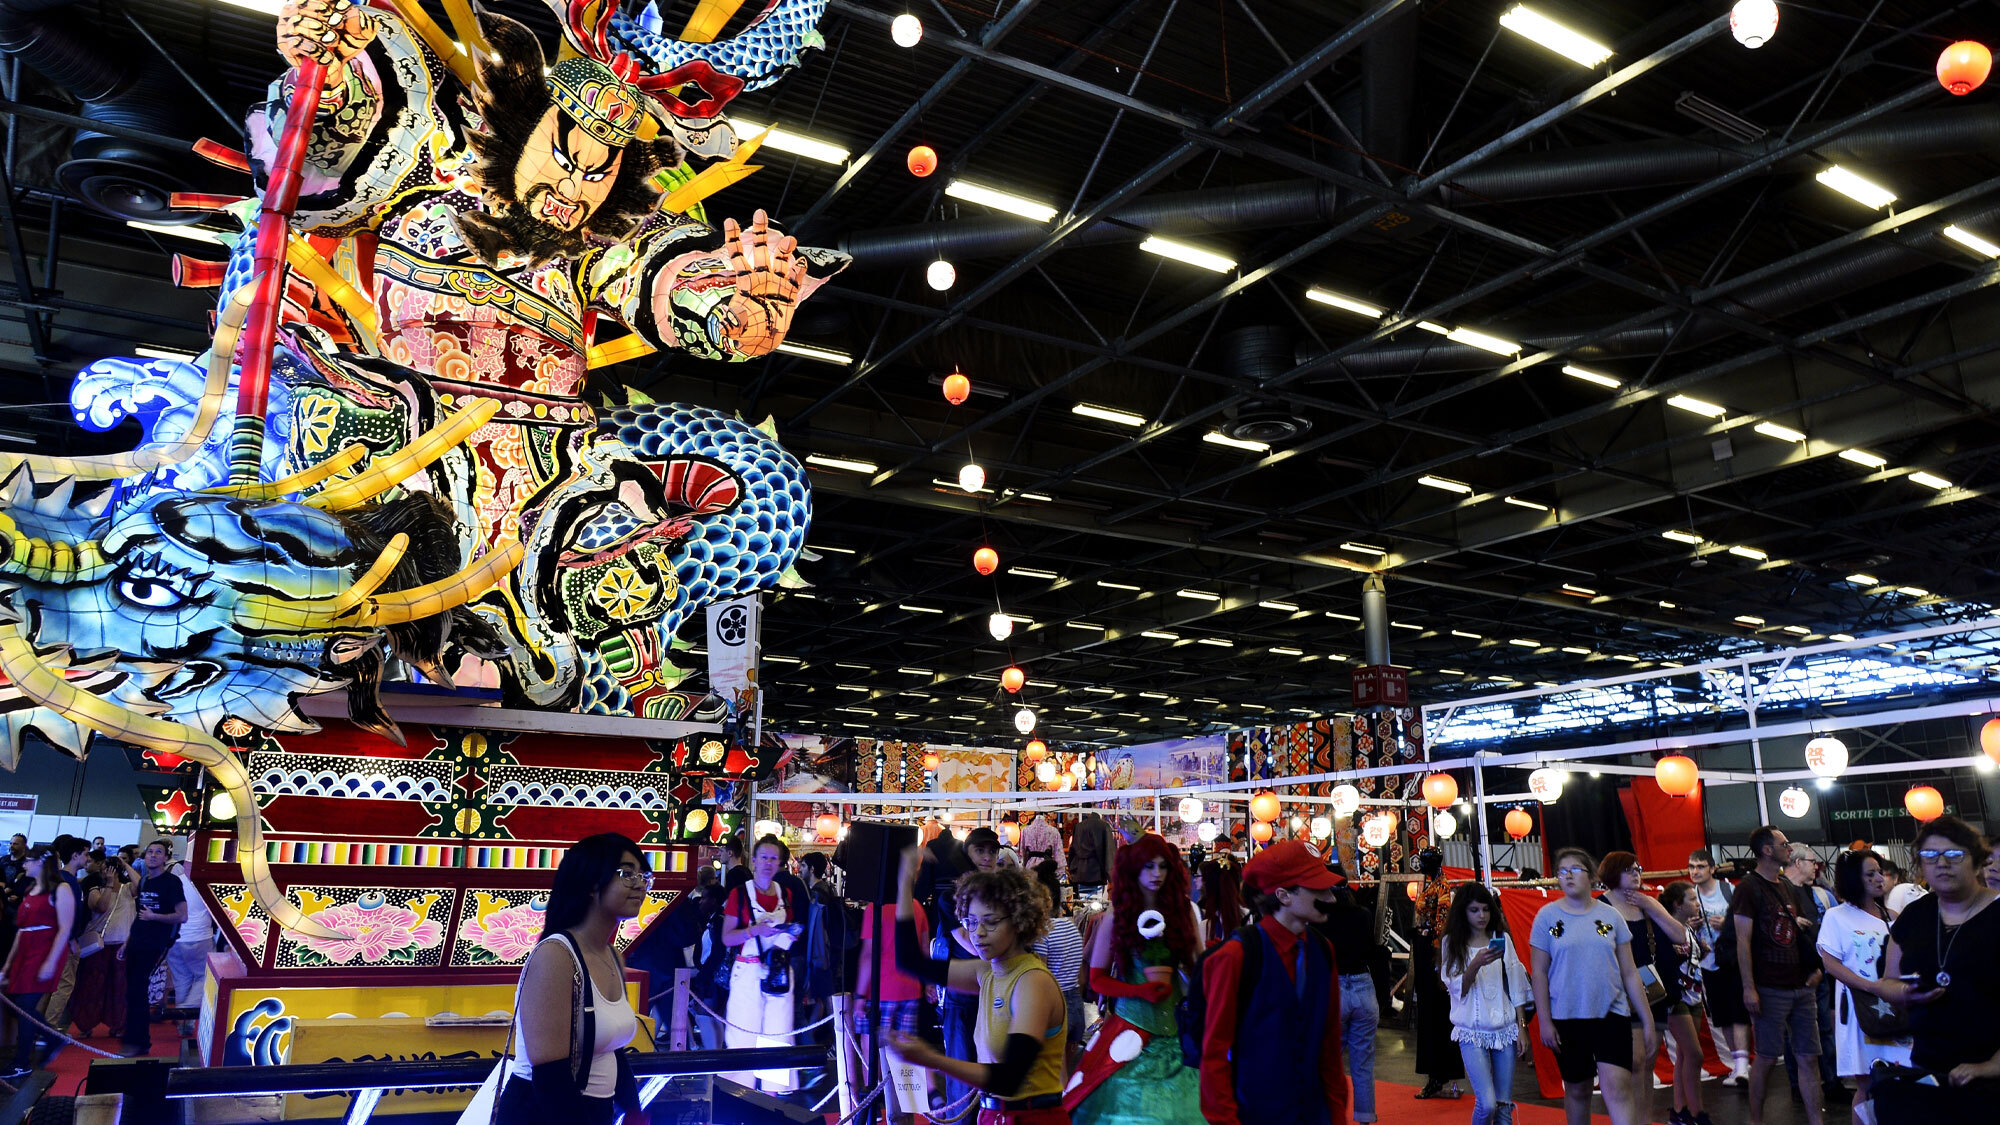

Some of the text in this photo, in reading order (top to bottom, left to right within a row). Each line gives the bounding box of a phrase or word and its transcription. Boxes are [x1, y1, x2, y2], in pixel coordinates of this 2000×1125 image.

[1354, 673, 1376, 681] R.I.A.
[1382, 672, 1404, 680] R.I.A.
[1834, 809, 1873, 820] SORTIE
[1878, 808, 1893, 818] DE
